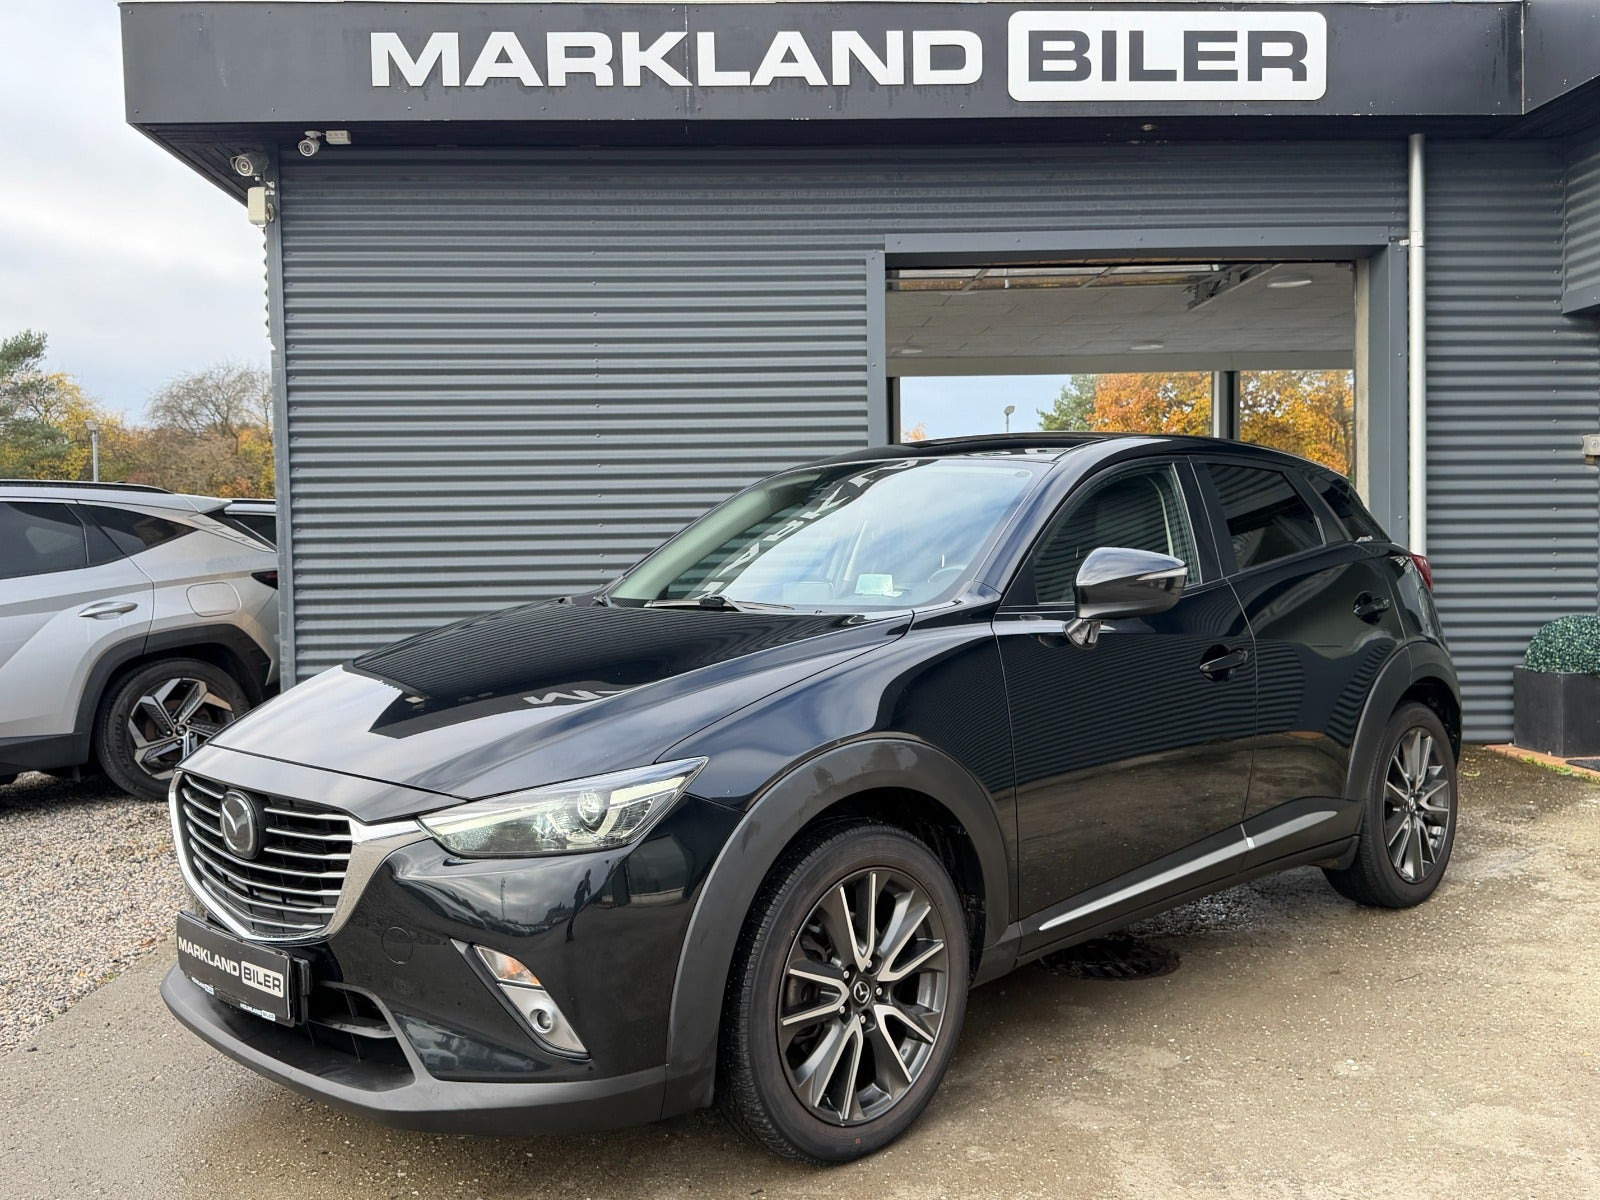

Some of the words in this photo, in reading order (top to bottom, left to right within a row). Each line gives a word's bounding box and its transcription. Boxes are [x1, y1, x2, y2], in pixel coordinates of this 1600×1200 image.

[370, 31, 982, 86] MARKLAND
[1028, 30, 1308, 82] BILER
[178, 937, 240, 977] MARKLAND
[243, 967, 282, 993] BILER
